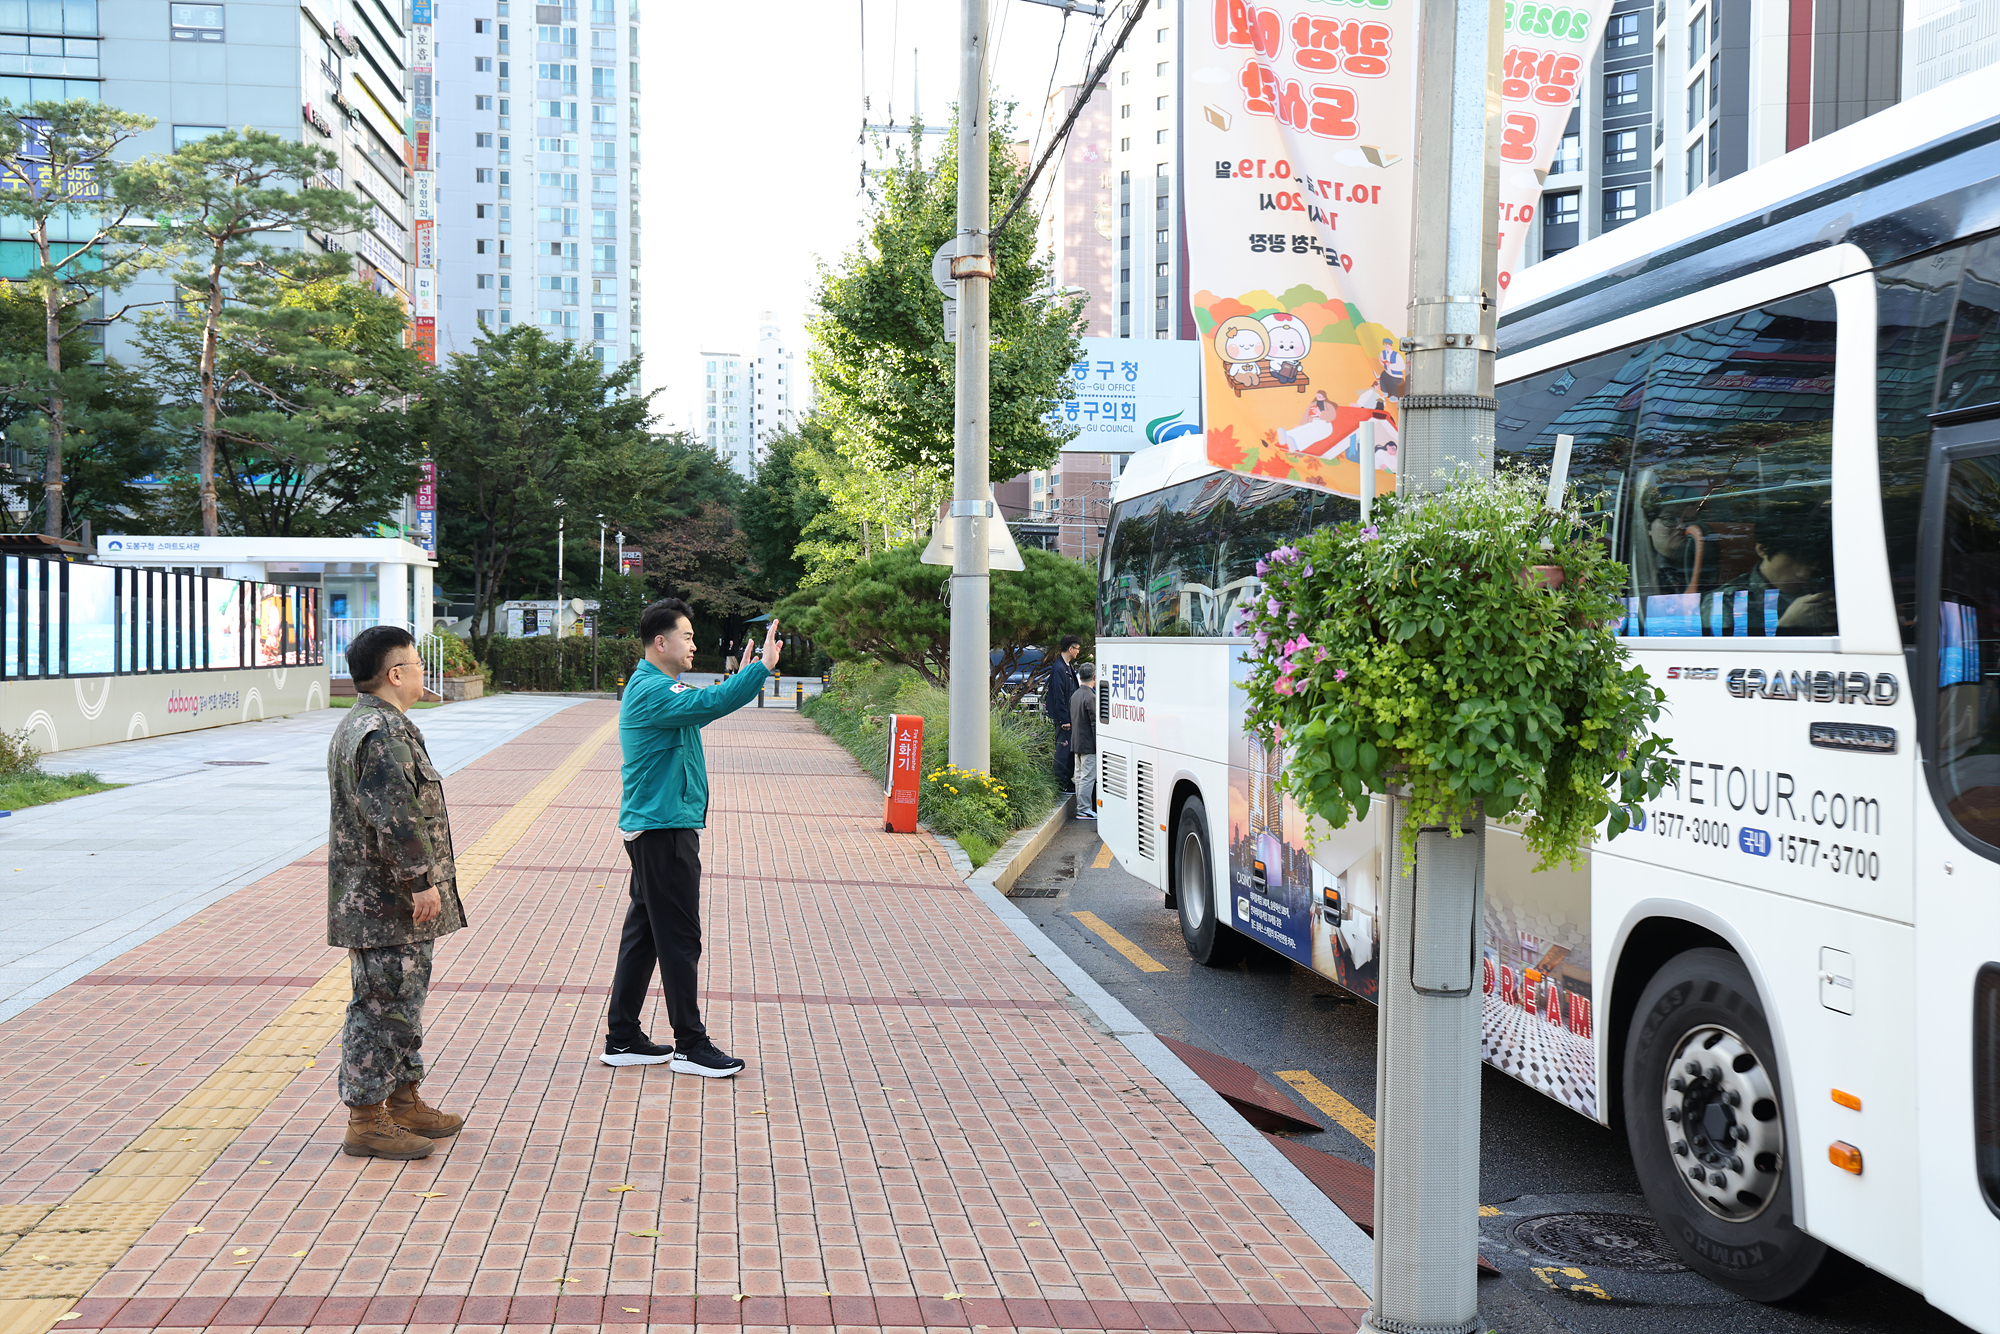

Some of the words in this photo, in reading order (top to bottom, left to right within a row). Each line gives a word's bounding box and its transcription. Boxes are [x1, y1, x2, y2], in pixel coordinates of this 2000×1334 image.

[68, 181, 99, 196] 0910
[419, 178, 428, 218] 정형외과
[1071, 360, 1138, 382] 봉구청
[1107, 383, 1136, 392] OFFICE
[1100, 424, 1134, 433] COUNCIL
[126, 542, 155, 551] 도봉구청
[157, 542, 200, 551] 스마트도서관
[1112, 664, 1146, 703] 롯데관광
[1725, 667, 1900, 707] GRANBIRD
[168, 689, 199, 717] dobong
[898, 729, 911, 771] 소화기
[1651, 809, 1730, 849] 1577-3000
[1778, 833, 1880, 881] 1577-3700
[1236, 871, 1252, 889] CASINO
[1682, 1225, 1765, 1268] KUMHO
